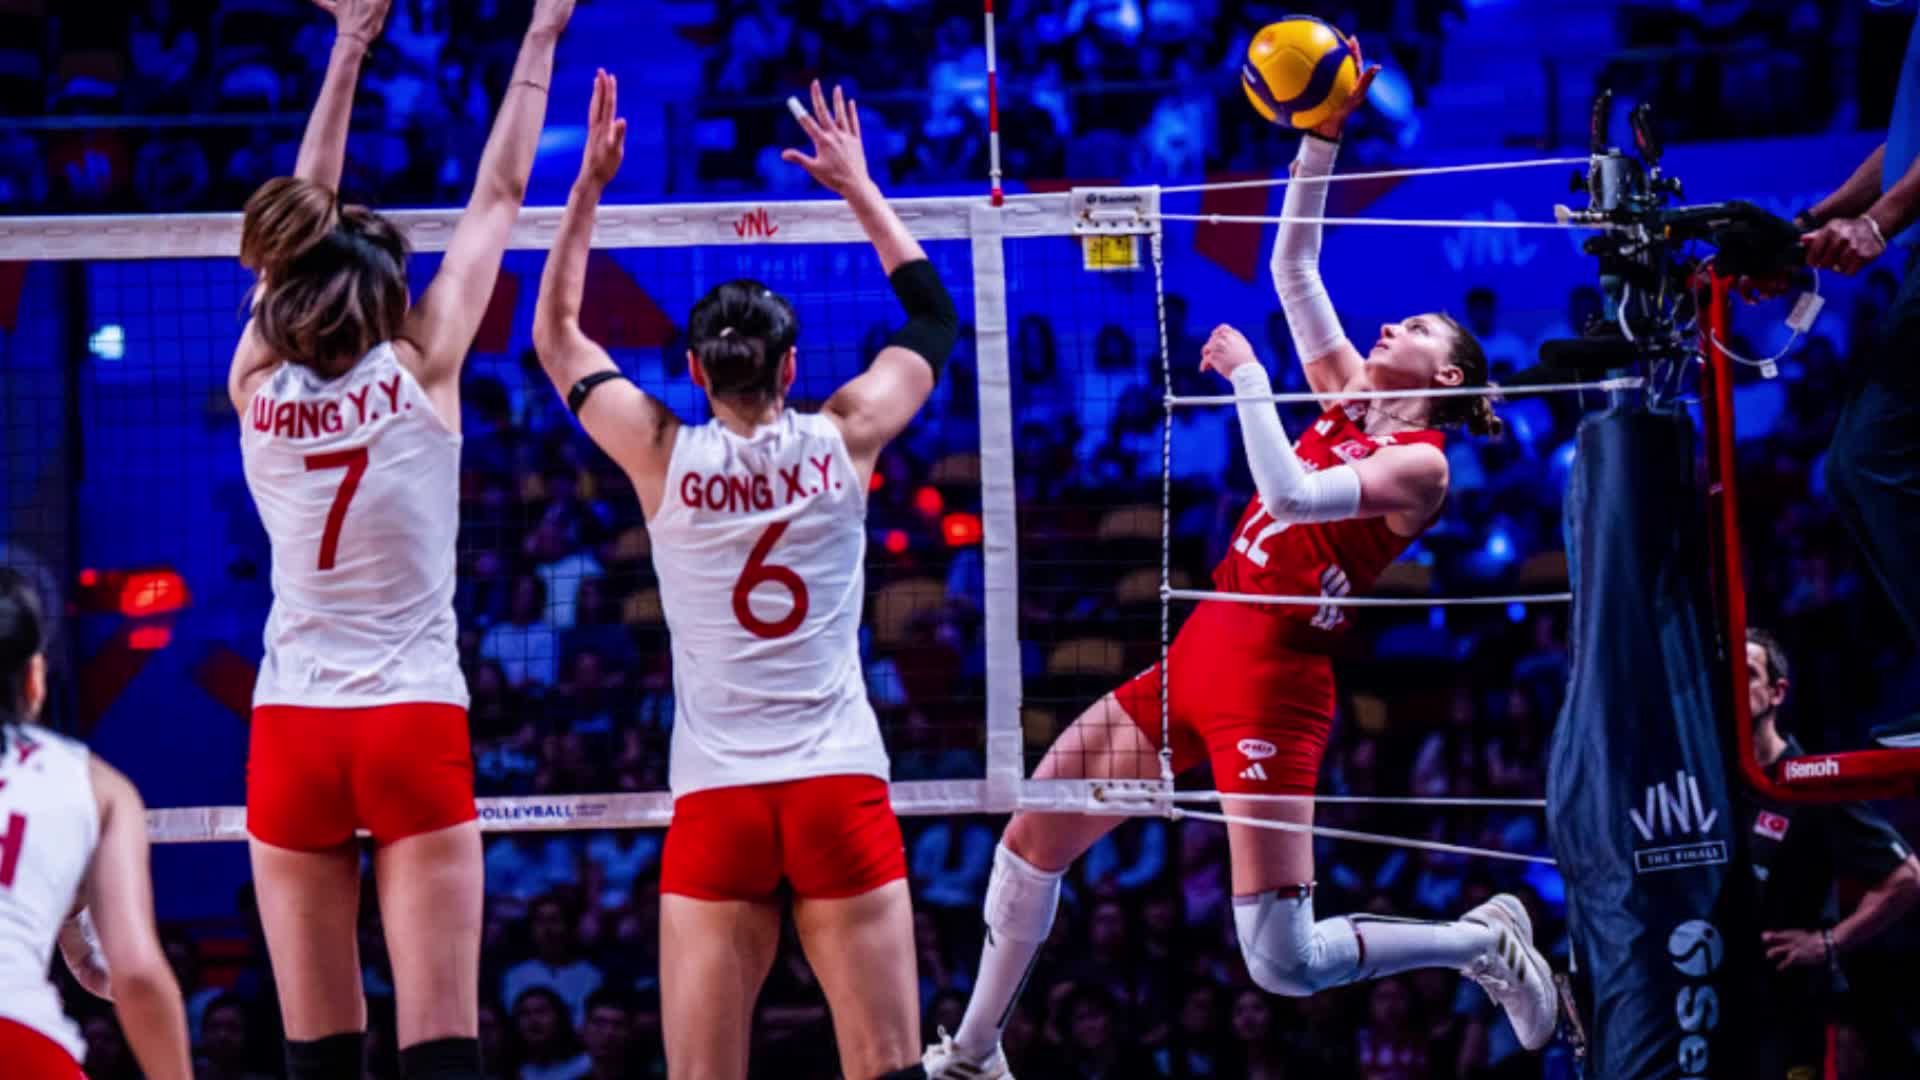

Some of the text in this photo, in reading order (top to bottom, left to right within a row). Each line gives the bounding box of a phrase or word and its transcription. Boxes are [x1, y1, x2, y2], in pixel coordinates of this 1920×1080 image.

[732, 207, 779, 238] VNL
[253, 373, 412, 439] WANG Y.Y.
[304, 447, 370, 571] 7
[680, 454, 842, 513] GONG X.Y.
[732, 519, 809, 640] 6
[1629, 769, 1718, 840] VNL
[1676, 985, 1719, 1080] Se
